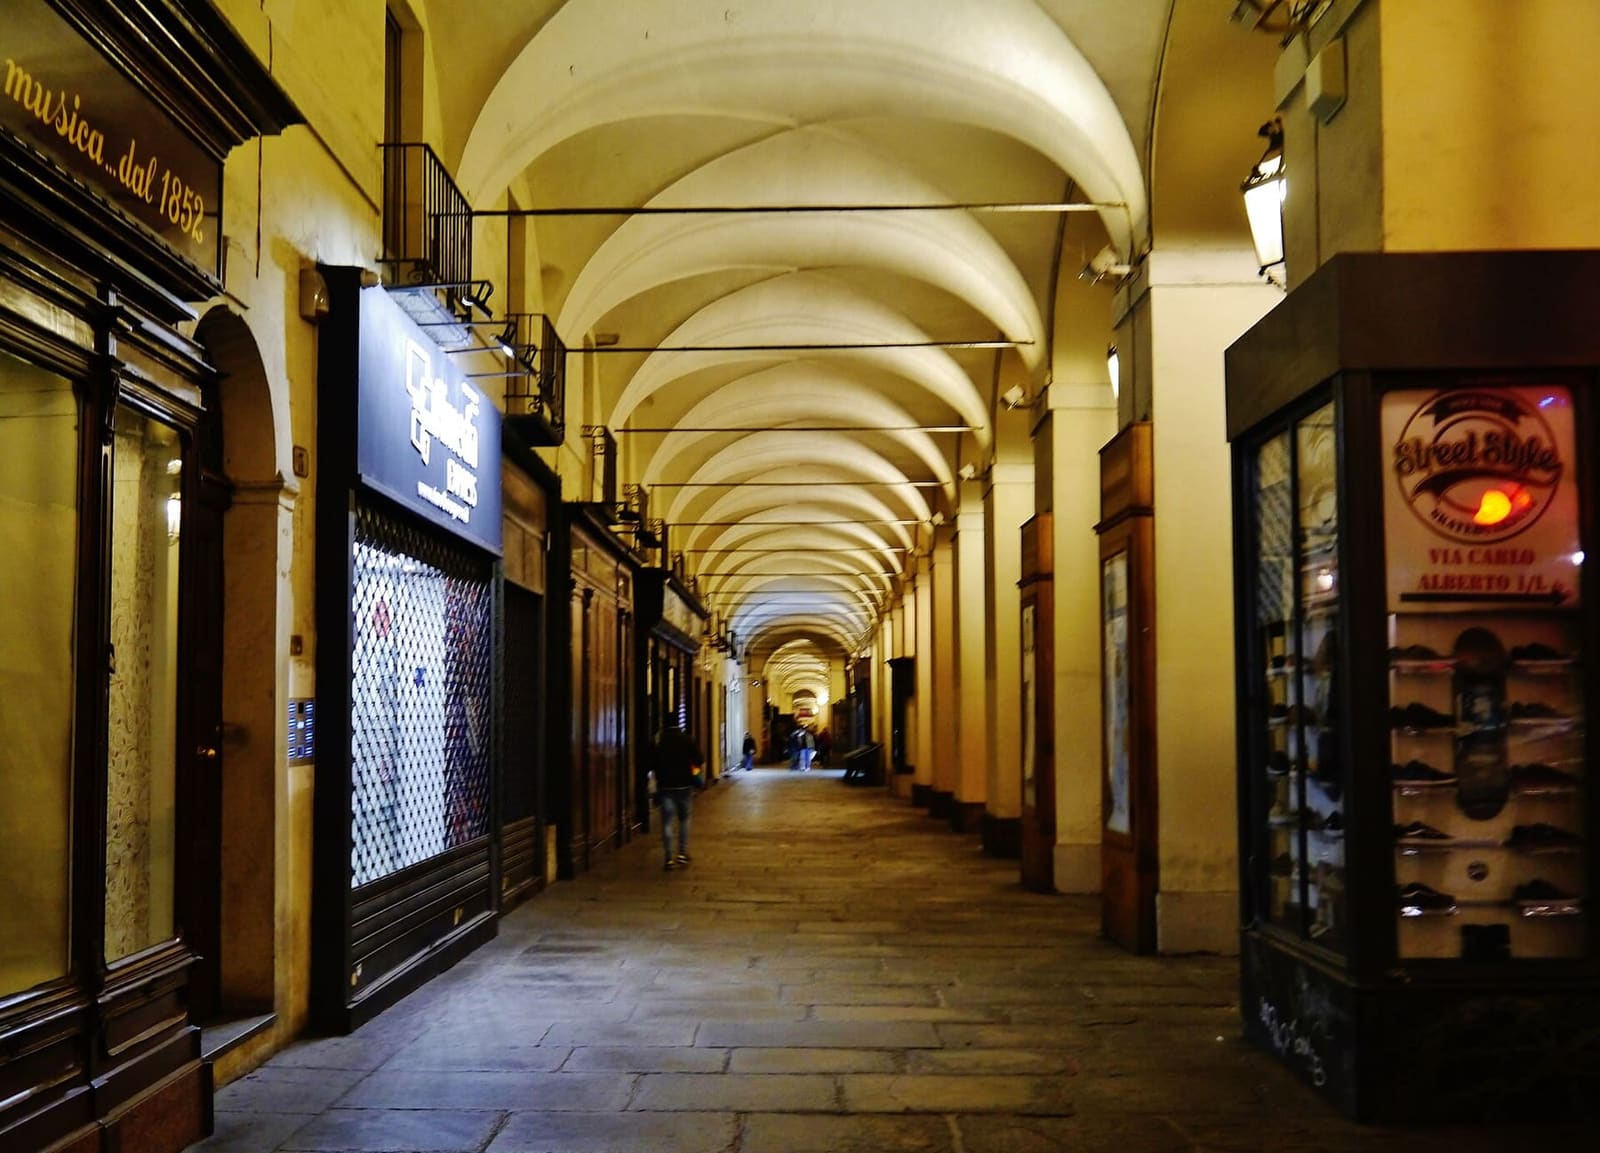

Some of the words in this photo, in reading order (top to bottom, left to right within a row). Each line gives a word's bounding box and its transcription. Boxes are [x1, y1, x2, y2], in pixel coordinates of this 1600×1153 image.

[159, 169, 205, 245] 1852
[1395, 431, 1479, 474] Street
[1482, 429, 1561, 473] Style
[1428, 549, 1463, 565] VIA
[1467, 549, 1536, 566] CARLO
[1417, 574, 1511, 591] ALBERTO
